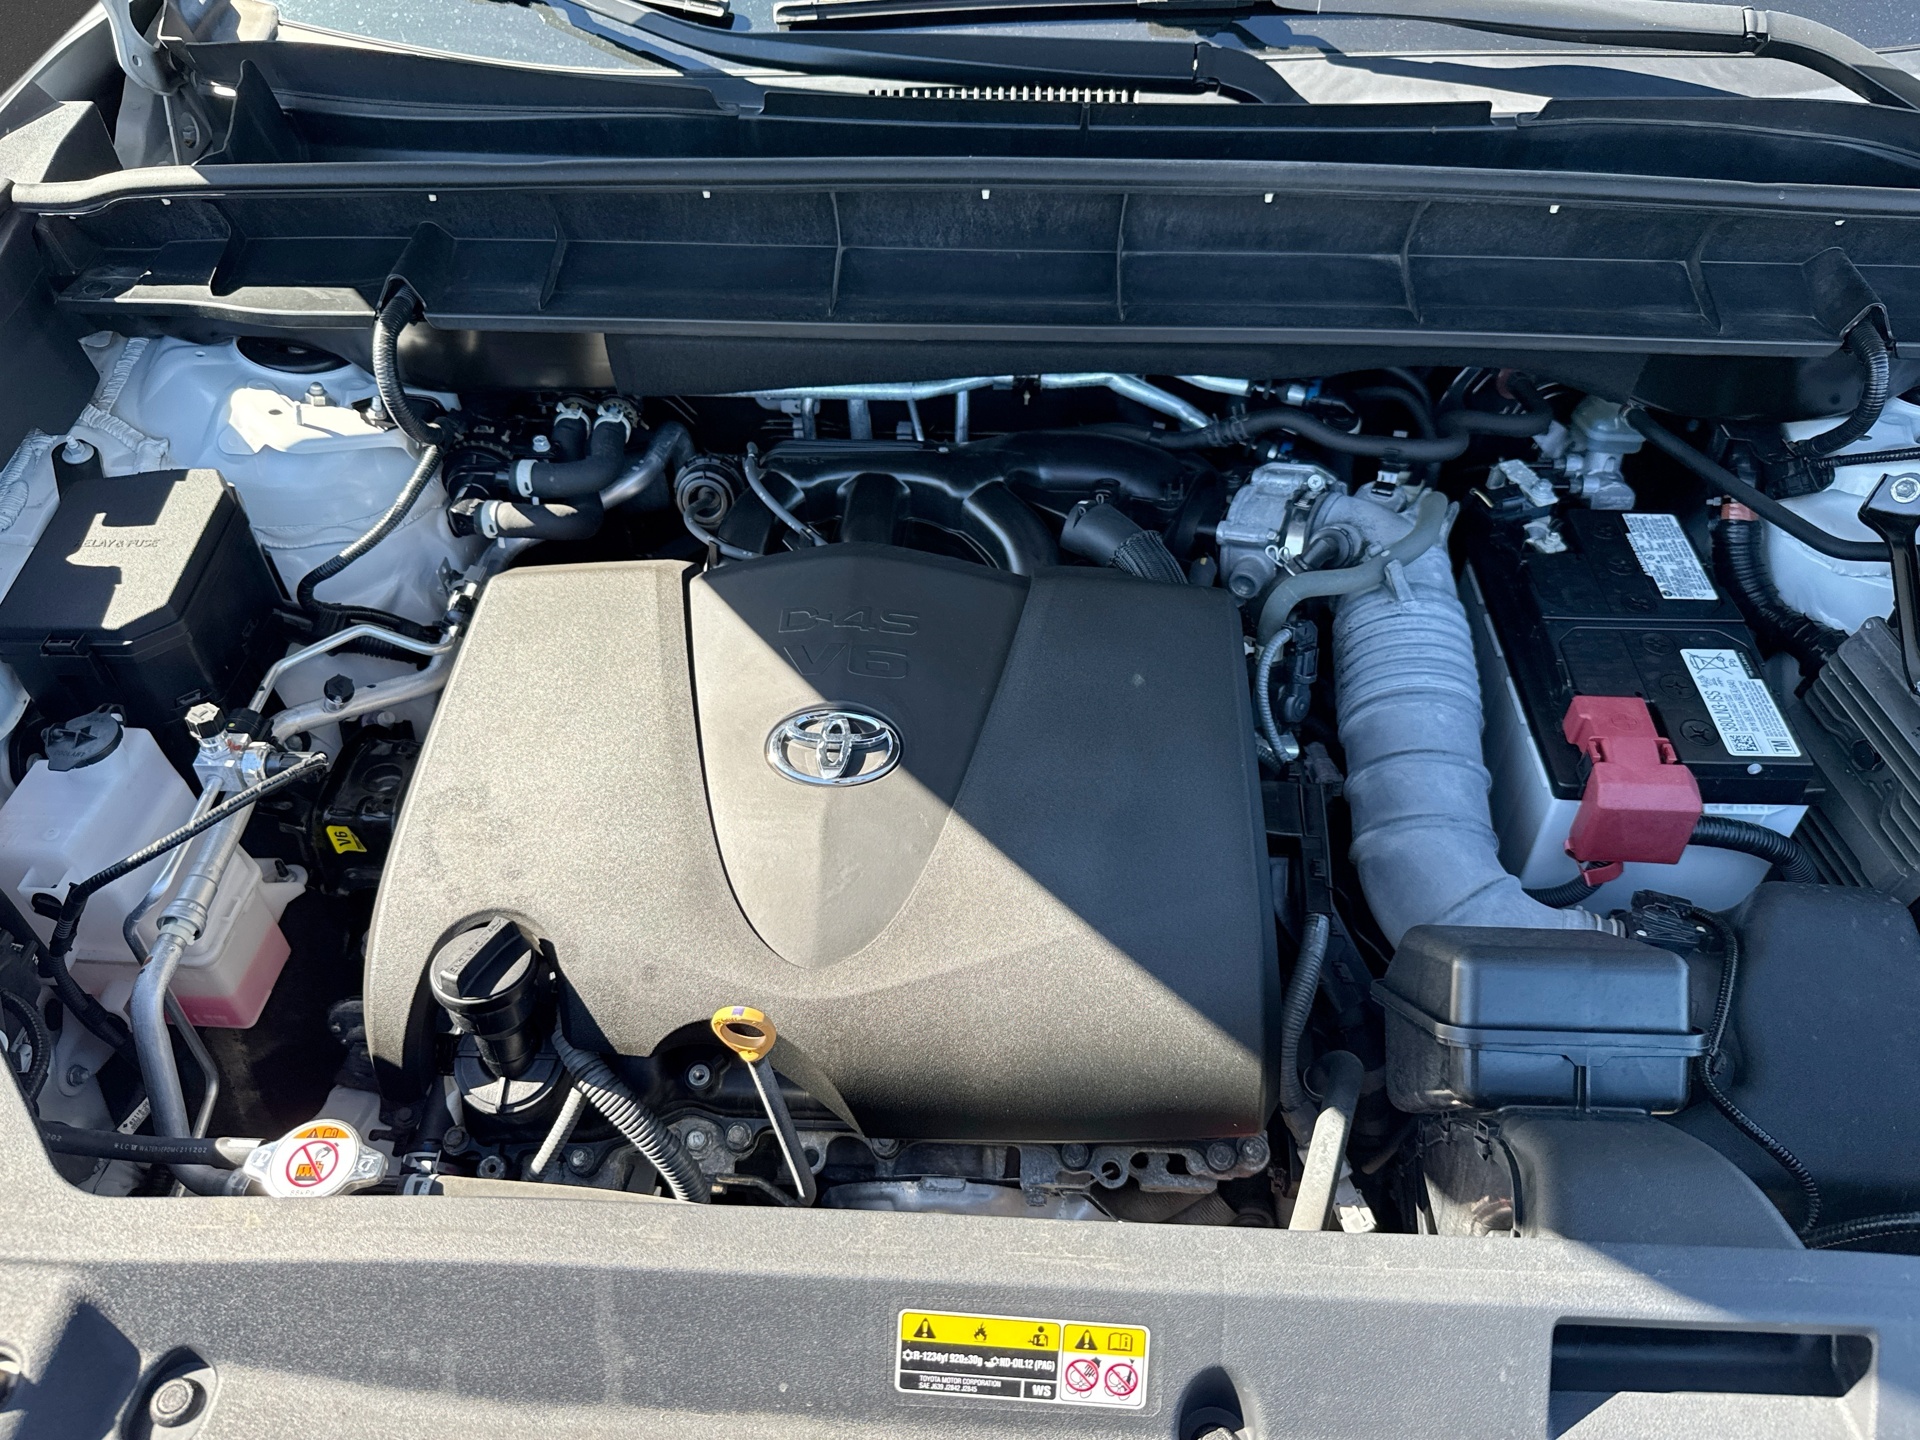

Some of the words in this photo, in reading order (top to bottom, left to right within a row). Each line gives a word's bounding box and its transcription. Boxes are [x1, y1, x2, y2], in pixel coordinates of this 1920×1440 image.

[126, 539, 160, 548] FUSE
[778, 606, 920, 637] D-4S
[782, 642, 909, 680] V6
[1770, 740, 1793, 753] TM
[334, 831, 352, 847] V6
[913, 1350, 949, 1364] R-1234yf
[1034, 1360, 1055, 1372] (PAG)
[919, 1374, 940, 1382] TOYOTA
[941, 1376, 962, 1384] MOTOR
[962, 1378, 1002, 1387] CORPORATION
[1032, 1384, 1052, 1397] WS
